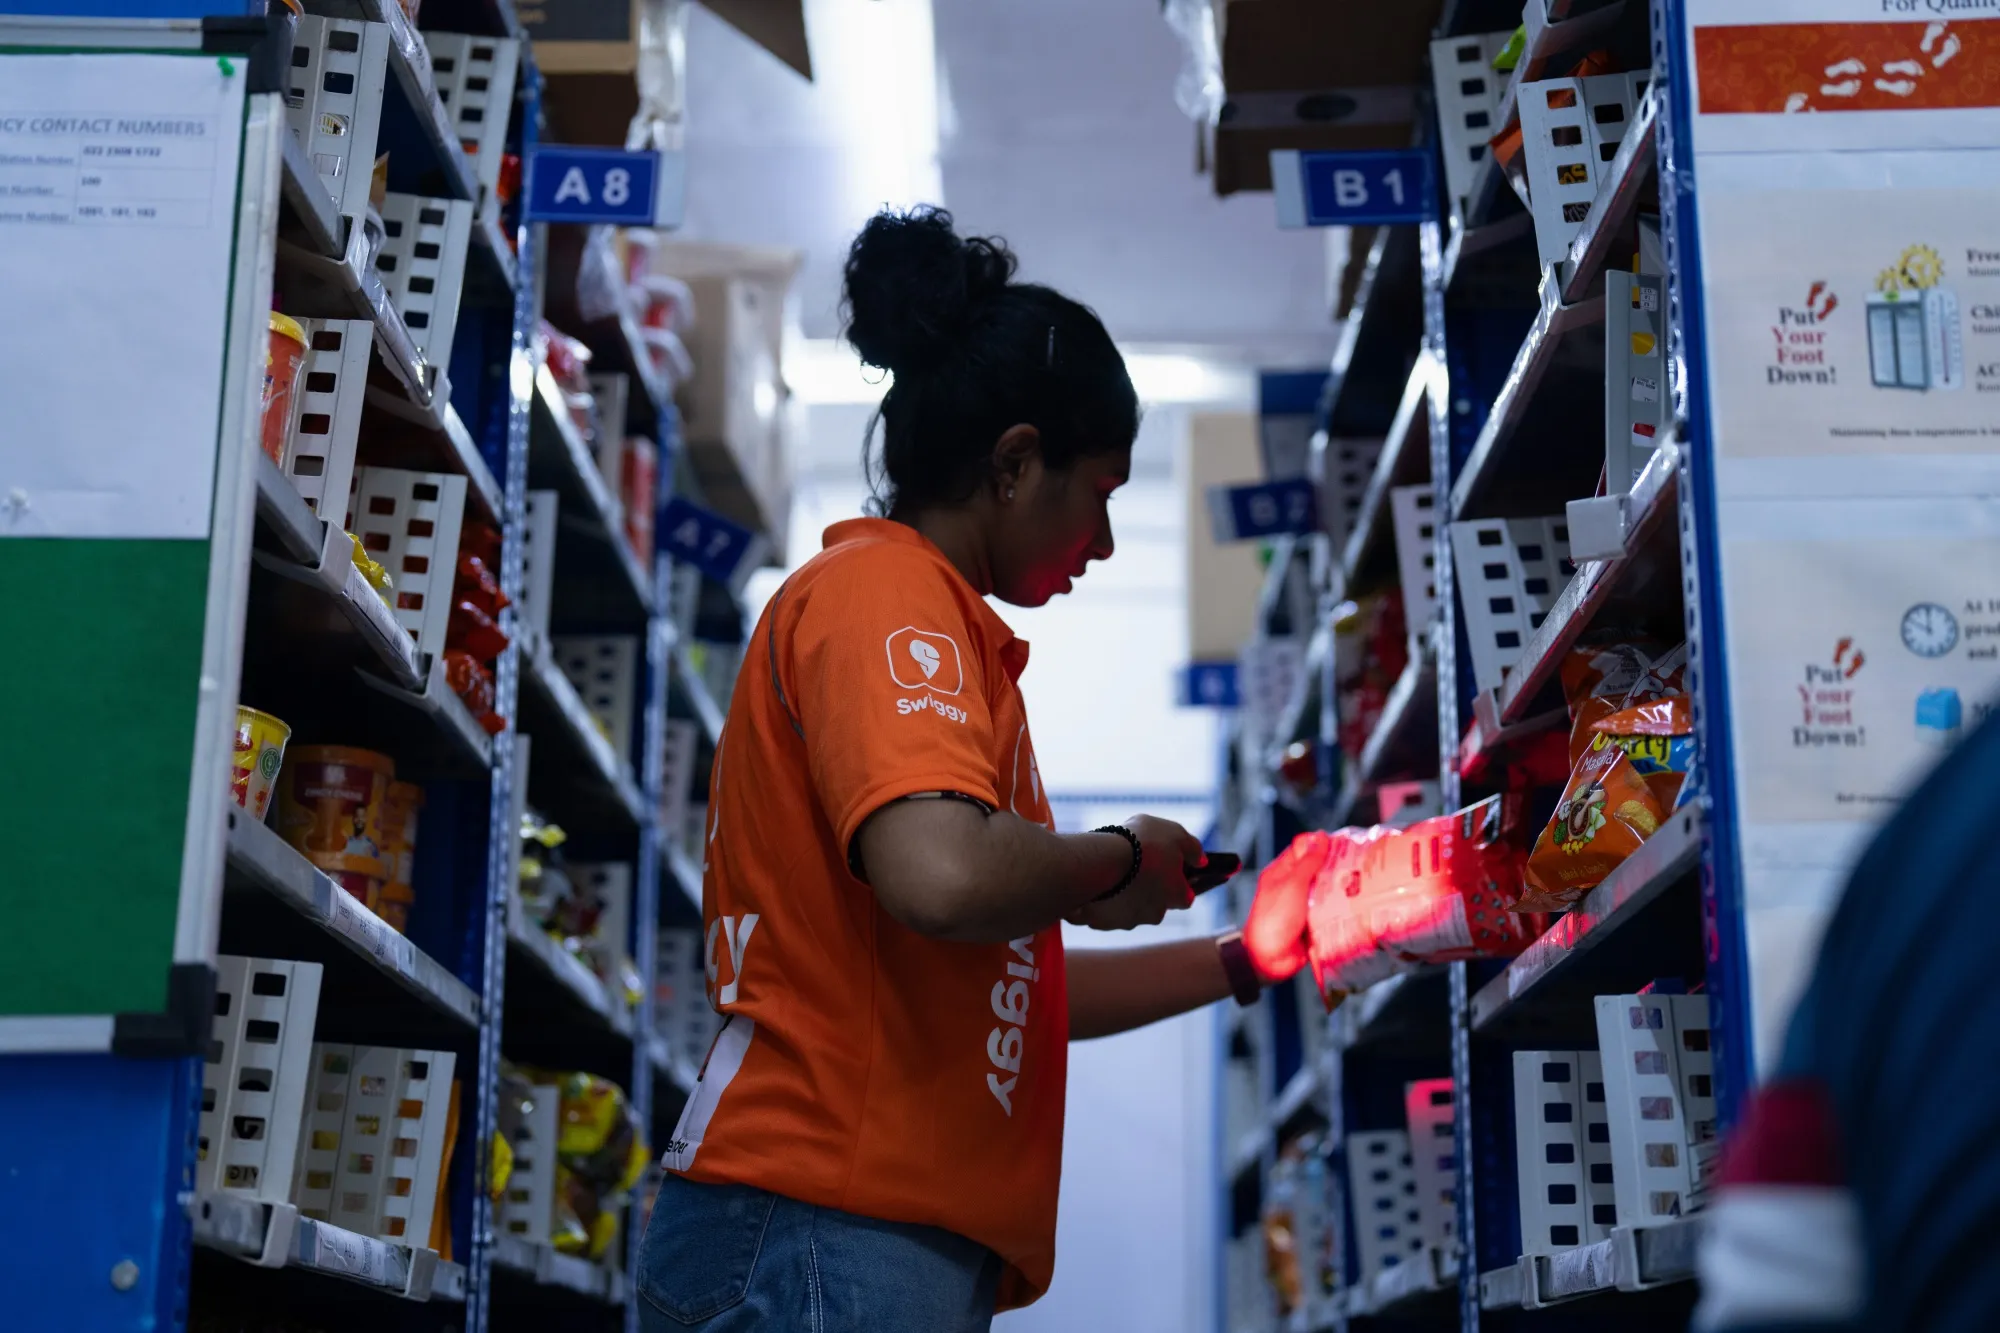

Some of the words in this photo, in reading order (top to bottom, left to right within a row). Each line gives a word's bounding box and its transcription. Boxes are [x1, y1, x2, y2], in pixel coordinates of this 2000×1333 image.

[30, 118, 113, 134] CONTACT
[117, 119, 206, 137] NUMBERS
[554, 166, 591, 205] A
[602, 167, 630, 206] 8
[1333, 169, 1368, 207] B
[1382, 168, 1404, 206] 1
[1778, 306, 1816, 326] Put
[1771, 326, 1827, 345] Your
[1776, 347, 1824, 364] Foot
[1766, 366, 1837, 385] Down!
[1805, 665, 1844, 684] Put
[1798, 684, 1853, 704] Your
[896, 692, 967, 724] Swiggy
[1803, 705, 1852, 725] Foot
[1792, 728, 1866, 748] Down!
[1580, 750, 1614, 773] Masala
